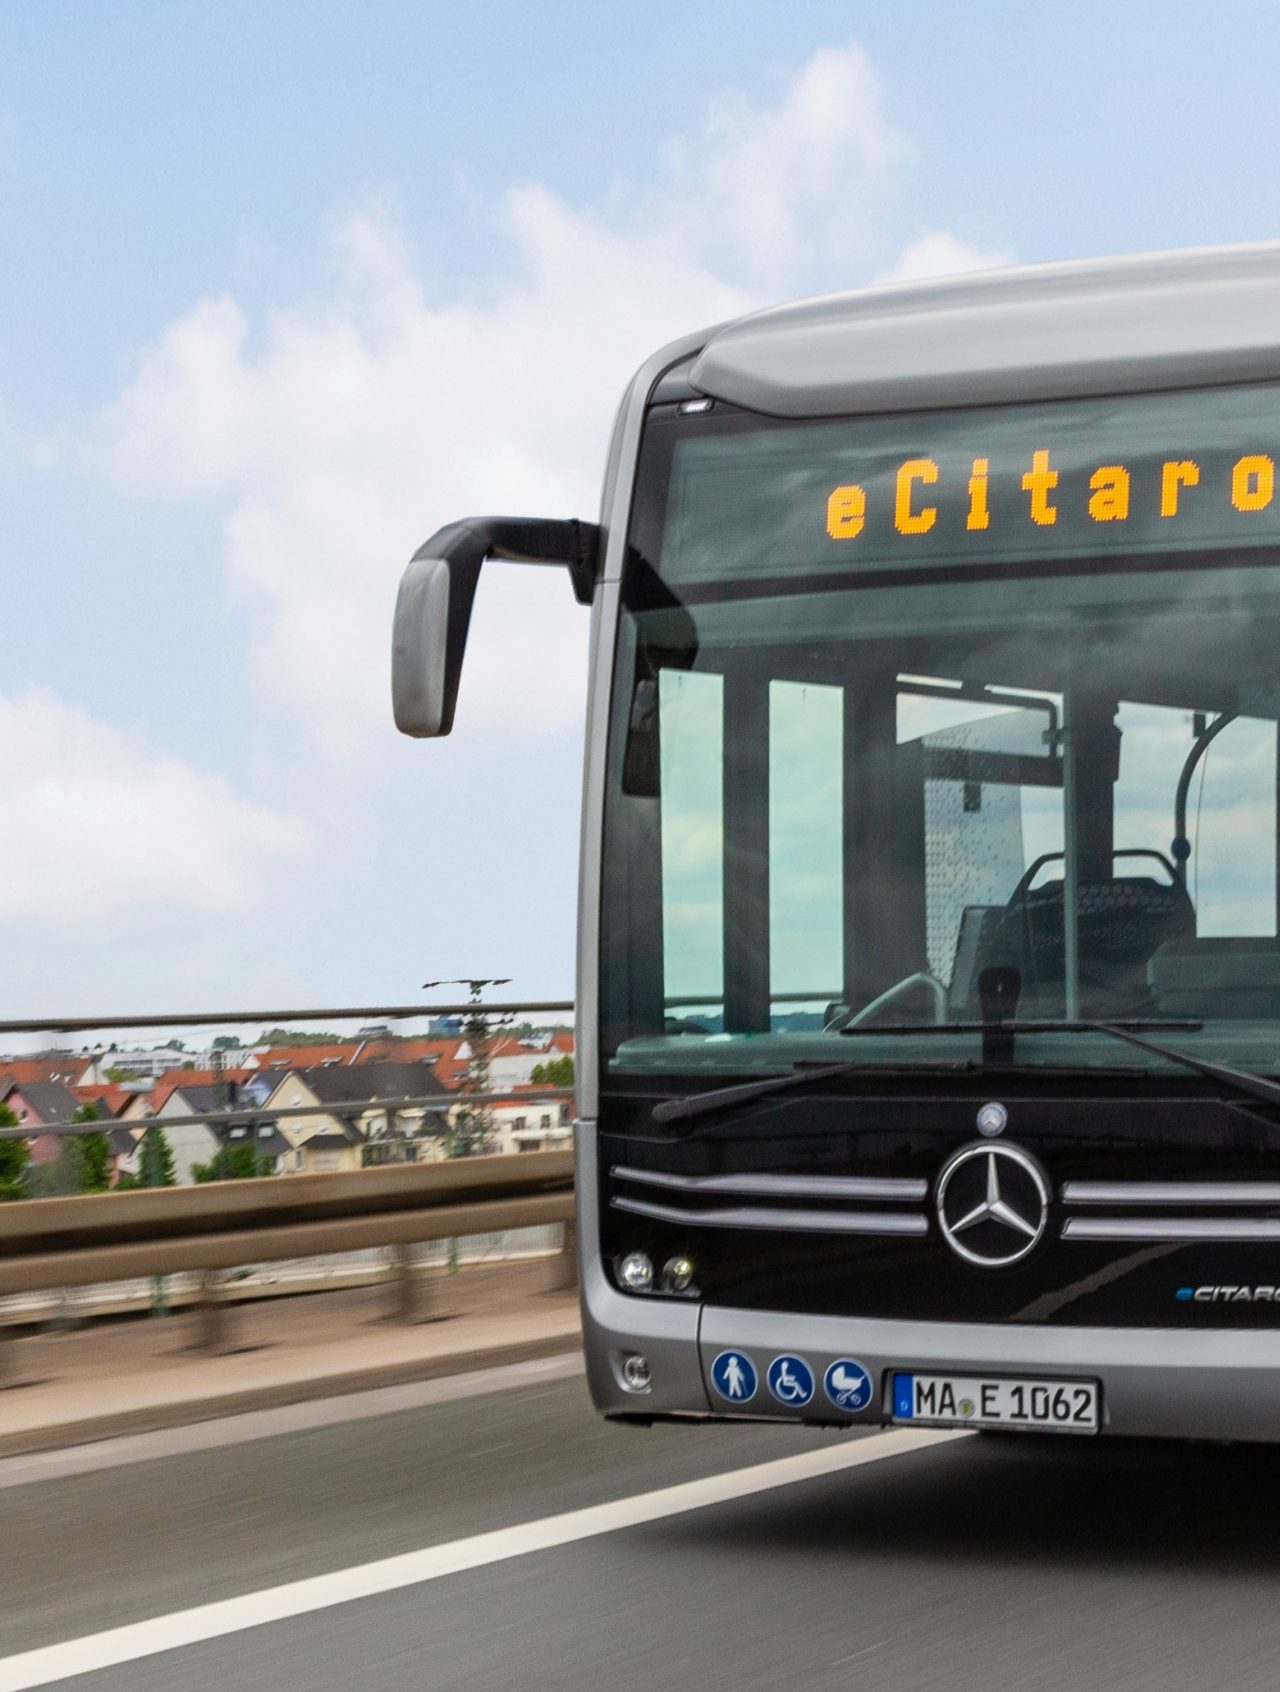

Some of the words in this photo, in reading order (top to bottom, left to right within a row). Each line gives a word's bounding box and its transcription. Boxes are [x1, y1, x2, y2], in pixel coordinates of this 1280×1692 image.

[825, 449, 1275, 539] eCitaro
[915, 1381, 957, 1416] MA
[981, 1384, 1001, 1418] E
[1009, 1385, 1092, 1422] 1062
